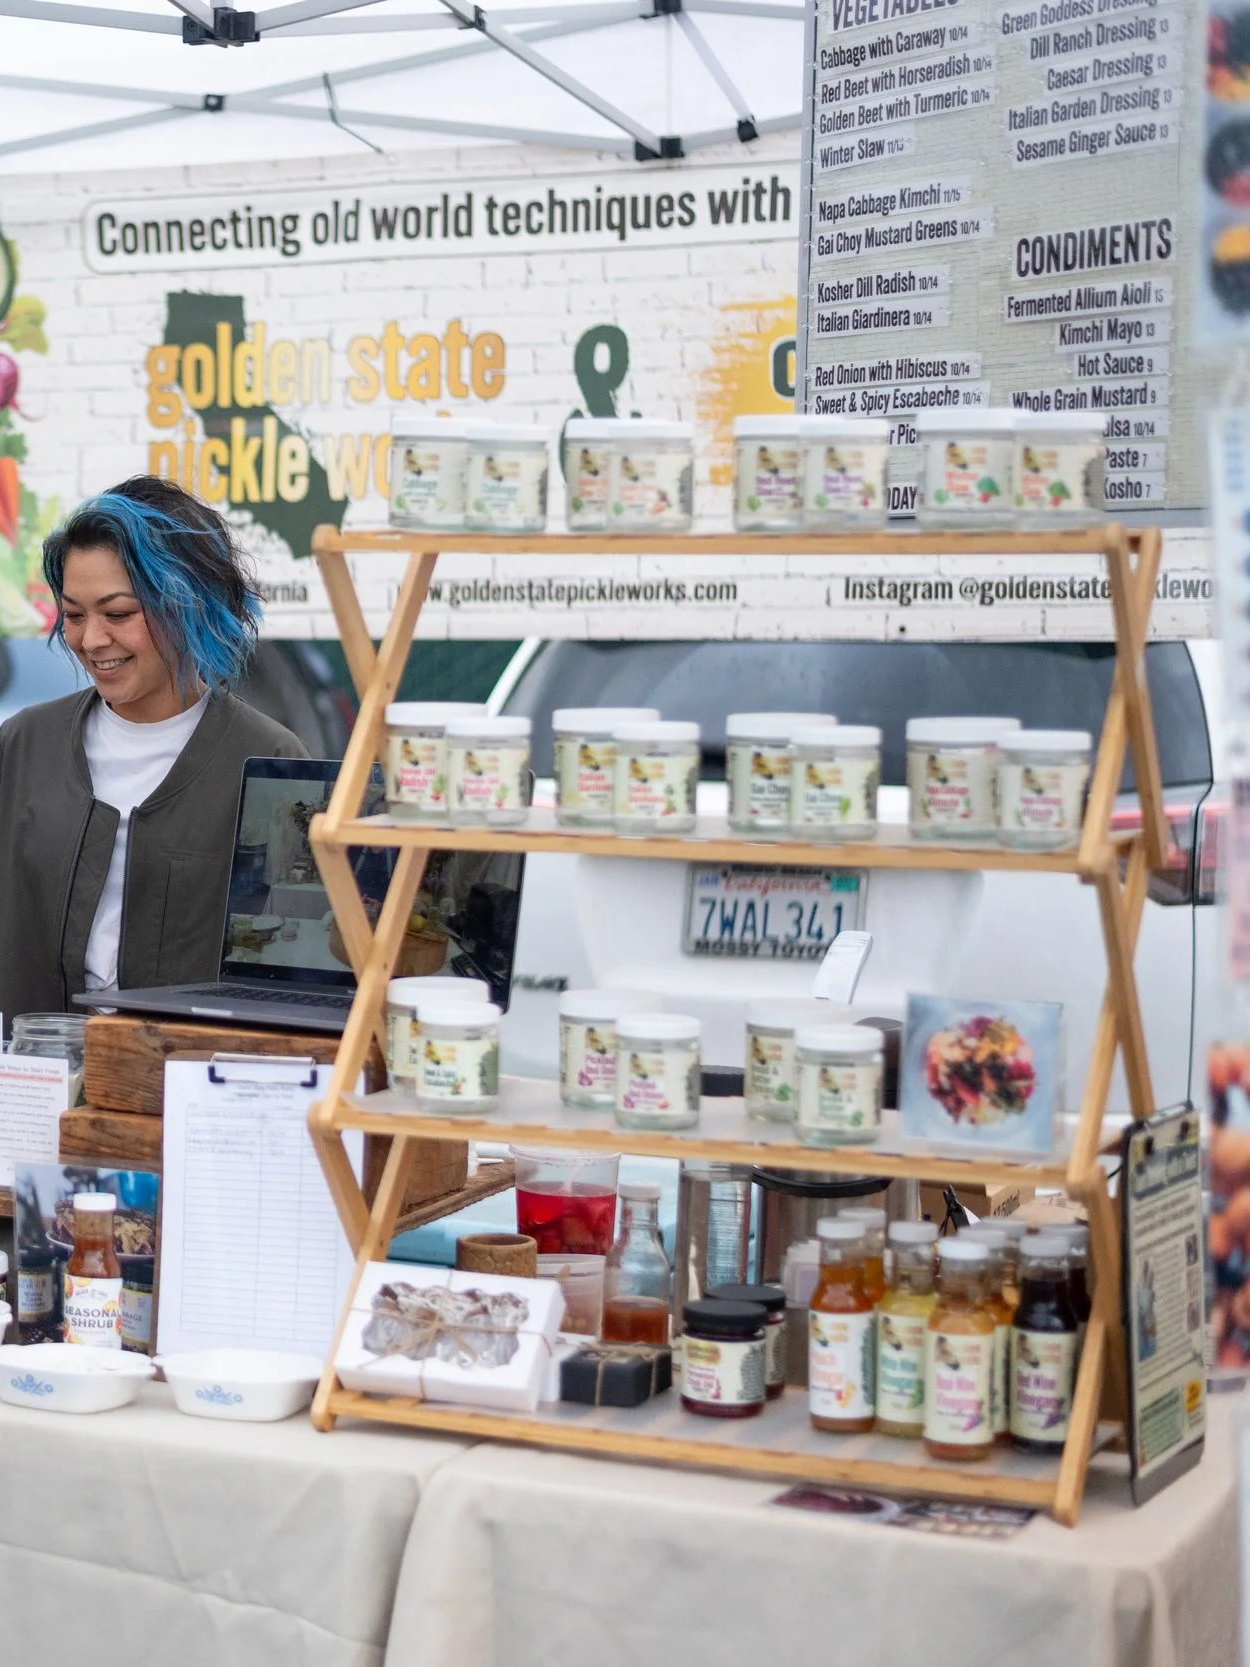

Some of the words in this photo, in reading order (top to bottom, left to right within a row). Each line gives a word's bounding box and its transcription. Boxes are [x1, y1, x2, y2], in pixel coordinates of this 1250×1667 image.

[1002, 12, 1037, 35] Green
[1040, 0, 1094, 26] Goddess
[821, 45, 866, 70] Cabbage
[869, 35, 893, 59] with
[896, 27, 946, 53] Caraway
[949, 26, 968, 41] 10/14
[1031, 35, 1050, 60] Dill
[1054, 26, 1092, 55] Ranch
[1097, 16, 1156, 46] Dressing
[1160, 18, 1169, 33] 13
[821, 77, 840, 104] Red
[844, 76, 869, 99] Beet
[872, 70, 895, 93] with
[899, 53, 970, 88] Horseradish
[1047, 64, 1089, 91] Caesar
[1093, 52, 1153, 81] Dressing
[1157, 54, 1167, 69] 13
[820, 108, 857, 134] Golden
[858, 102, 883, 126] Beet
[886, 98, 910, 120] with
[914, 86, 968, 114] Turmeric
[1008, 105, 1048, 131] Italian
[1051, 97, 1096, 123] Garden
[1100, 86, 1160, 114] Dressing
[1163, 88, 1172, 103] 13
[820, 145, 855, 169] Winter
[858, 138, 885, 160] Slaw
[1017, 138, 1065, 162] Sesame
[1069, 129, 1111, 155] Ginger
[1115, 122, 1156, 146] Sauce
[1160, 124, 1168, 138] 13
[98, 204, 301, 257] Connecting
[312, 198, 361, 247] old
[370, 191, 473, 241] world
[485, 184, 697, 241] techniques
[708, 174, 792, 225] with
[819, 201, 845, 224] Napa
[848, 193, 896, 217] Cabbage
[900, 183, 941, 209] Kimchi
[818, 233, 834, 256] Gai
[836, 232, 862, 255] Choy
[865, 222, 912, 249] Mustard
[915, 219, 958, 241] Greens
[960, 220, 980, 236] 10/14
[1016, 217, 1172, 278] CONDIMENTS
[817, 282, 853, 303] Kosher
[856, 276, 873, 298] Dill
[876, 271, 916, 295] Radish
[919, 276, 938, 290] 10/14
[1007, 290, 1072, 318] Fermented
[1075, 287, 1117, 311] Allium
[1120, 281, 1151, 305] Aioli
[1155, 288, 1164, 303] 15
[817, 310, 849, 333] Italian
[852, 307, 910, 330] Giardinera
[913, 311, 932, 325] 10/14
[1059, 320, 1103, 346] Kimchi
[1107, 318, 1142, 343] Mayo
[1146, 322, 1155, 337] 13
[145, 320, 331, 429] golden
[347, 319, 506, 403] state
[815, 365, 834, 387] Red
[837, 363, 866, 385] Onion
[869, 360, 892, 382] with
[895, 358, 948, 380] Hibiscus
[950, 362, 970, 376] 10/14
[1078, 355, 1100, 377] Hot
[1103, 352, 1144, 375] Sauce
[1147, 358, 1153, 372] 9
[815, 395, 846, 415] Sweet
[848, 392, 857, 413] &
[860, 390, 891, 416] Spicy
[893, 385, 959, 409] Escabeche
[1012, 391, 1050, 412] Whole
[1054, 387, 1087, 411] Grain
[1091, 382, 1147, 409] Mustard
[1151, 390, 1156, 404] 9
[1102, 415, 1130, 438] alsa
[1134, 422, 1155, 436] 10/14
[1142, 454, 1147, 467] 7
[1146, 484, 1150, 498] 7
[844, 575, 953, 606] Instagram
[64, 1304, 121, 1318] SEASONAL
[71, 1317, 114, 1329] SHRUB
